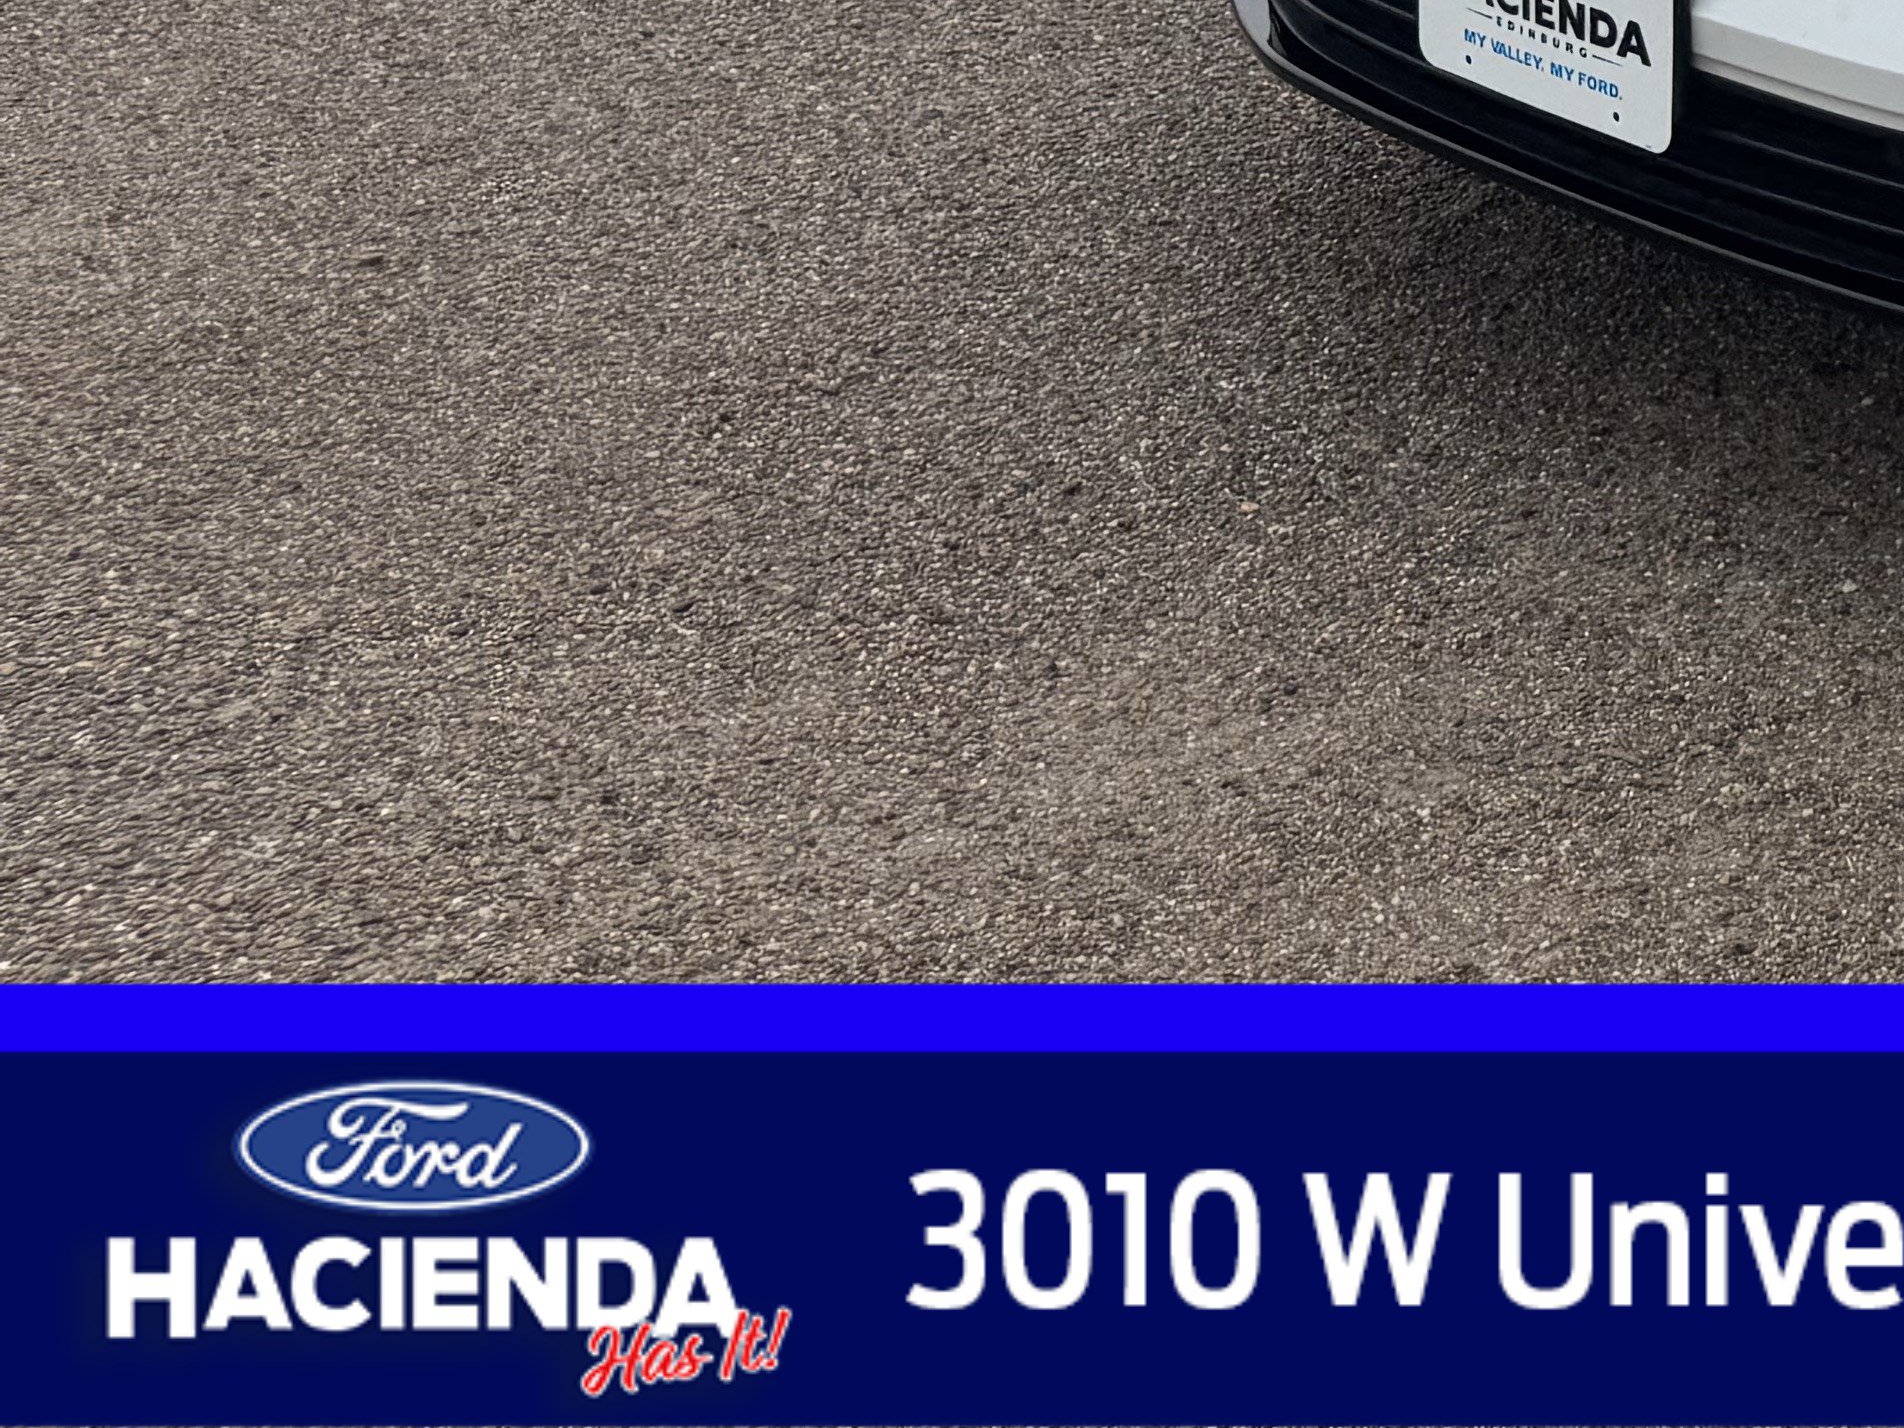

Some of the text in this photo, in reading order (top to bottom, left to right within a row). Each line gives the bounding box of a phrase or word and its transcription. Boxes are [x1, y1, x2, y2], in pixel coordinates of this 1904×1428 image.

[1463, 28, 1487, 49] MY
[1549, 61, 1575, 82] MY
[1496, 16, 1588, 59] EDINBURG
